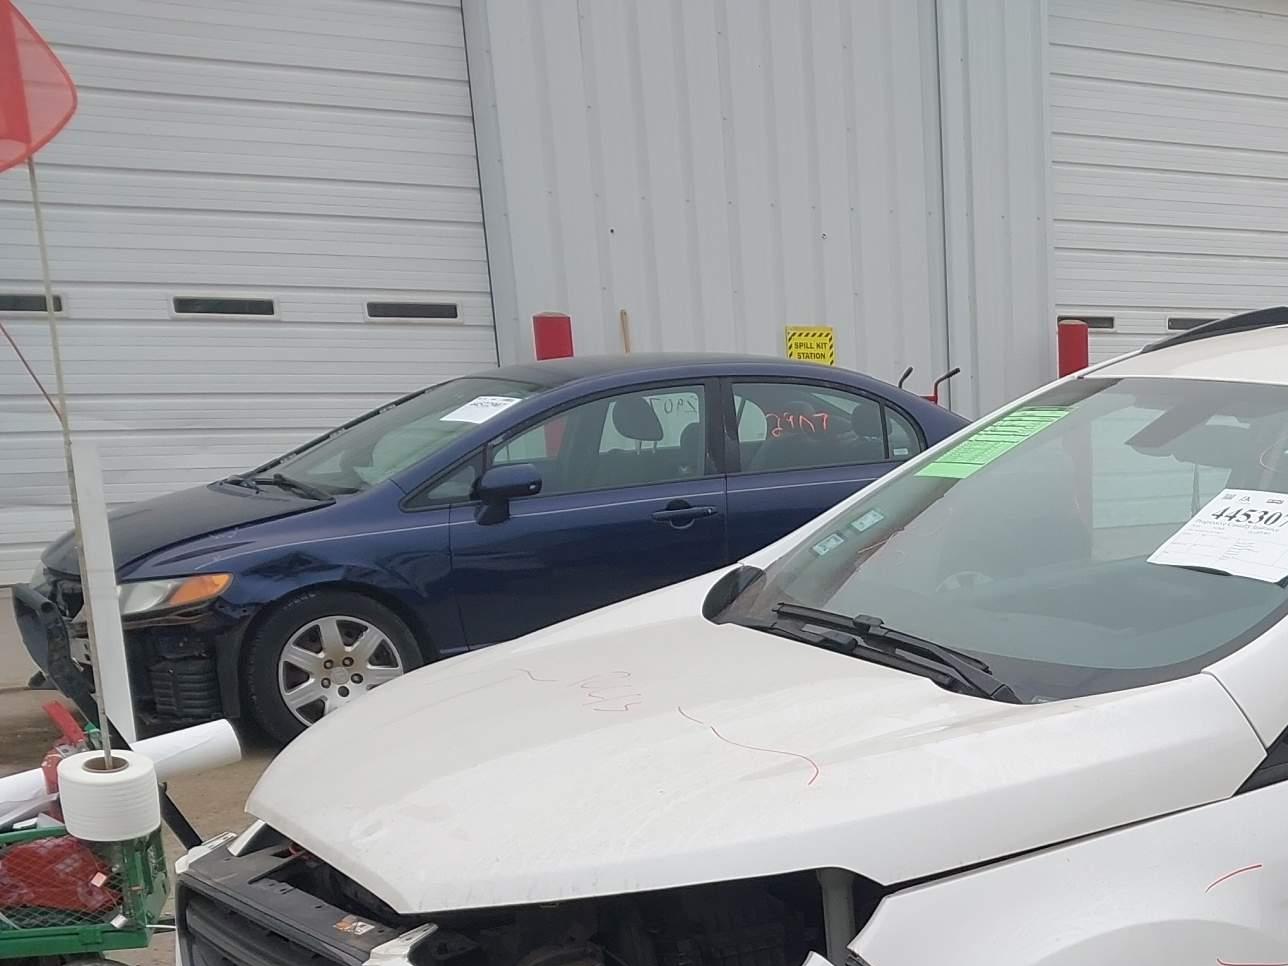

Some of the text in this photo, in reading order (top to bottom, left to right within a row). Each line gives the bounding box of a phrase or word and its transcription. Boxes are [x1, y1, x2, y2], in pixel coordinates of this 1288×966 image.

[794, 341, 828, 350] SPILL KIT
[796, 351, 826, 360] STATION
